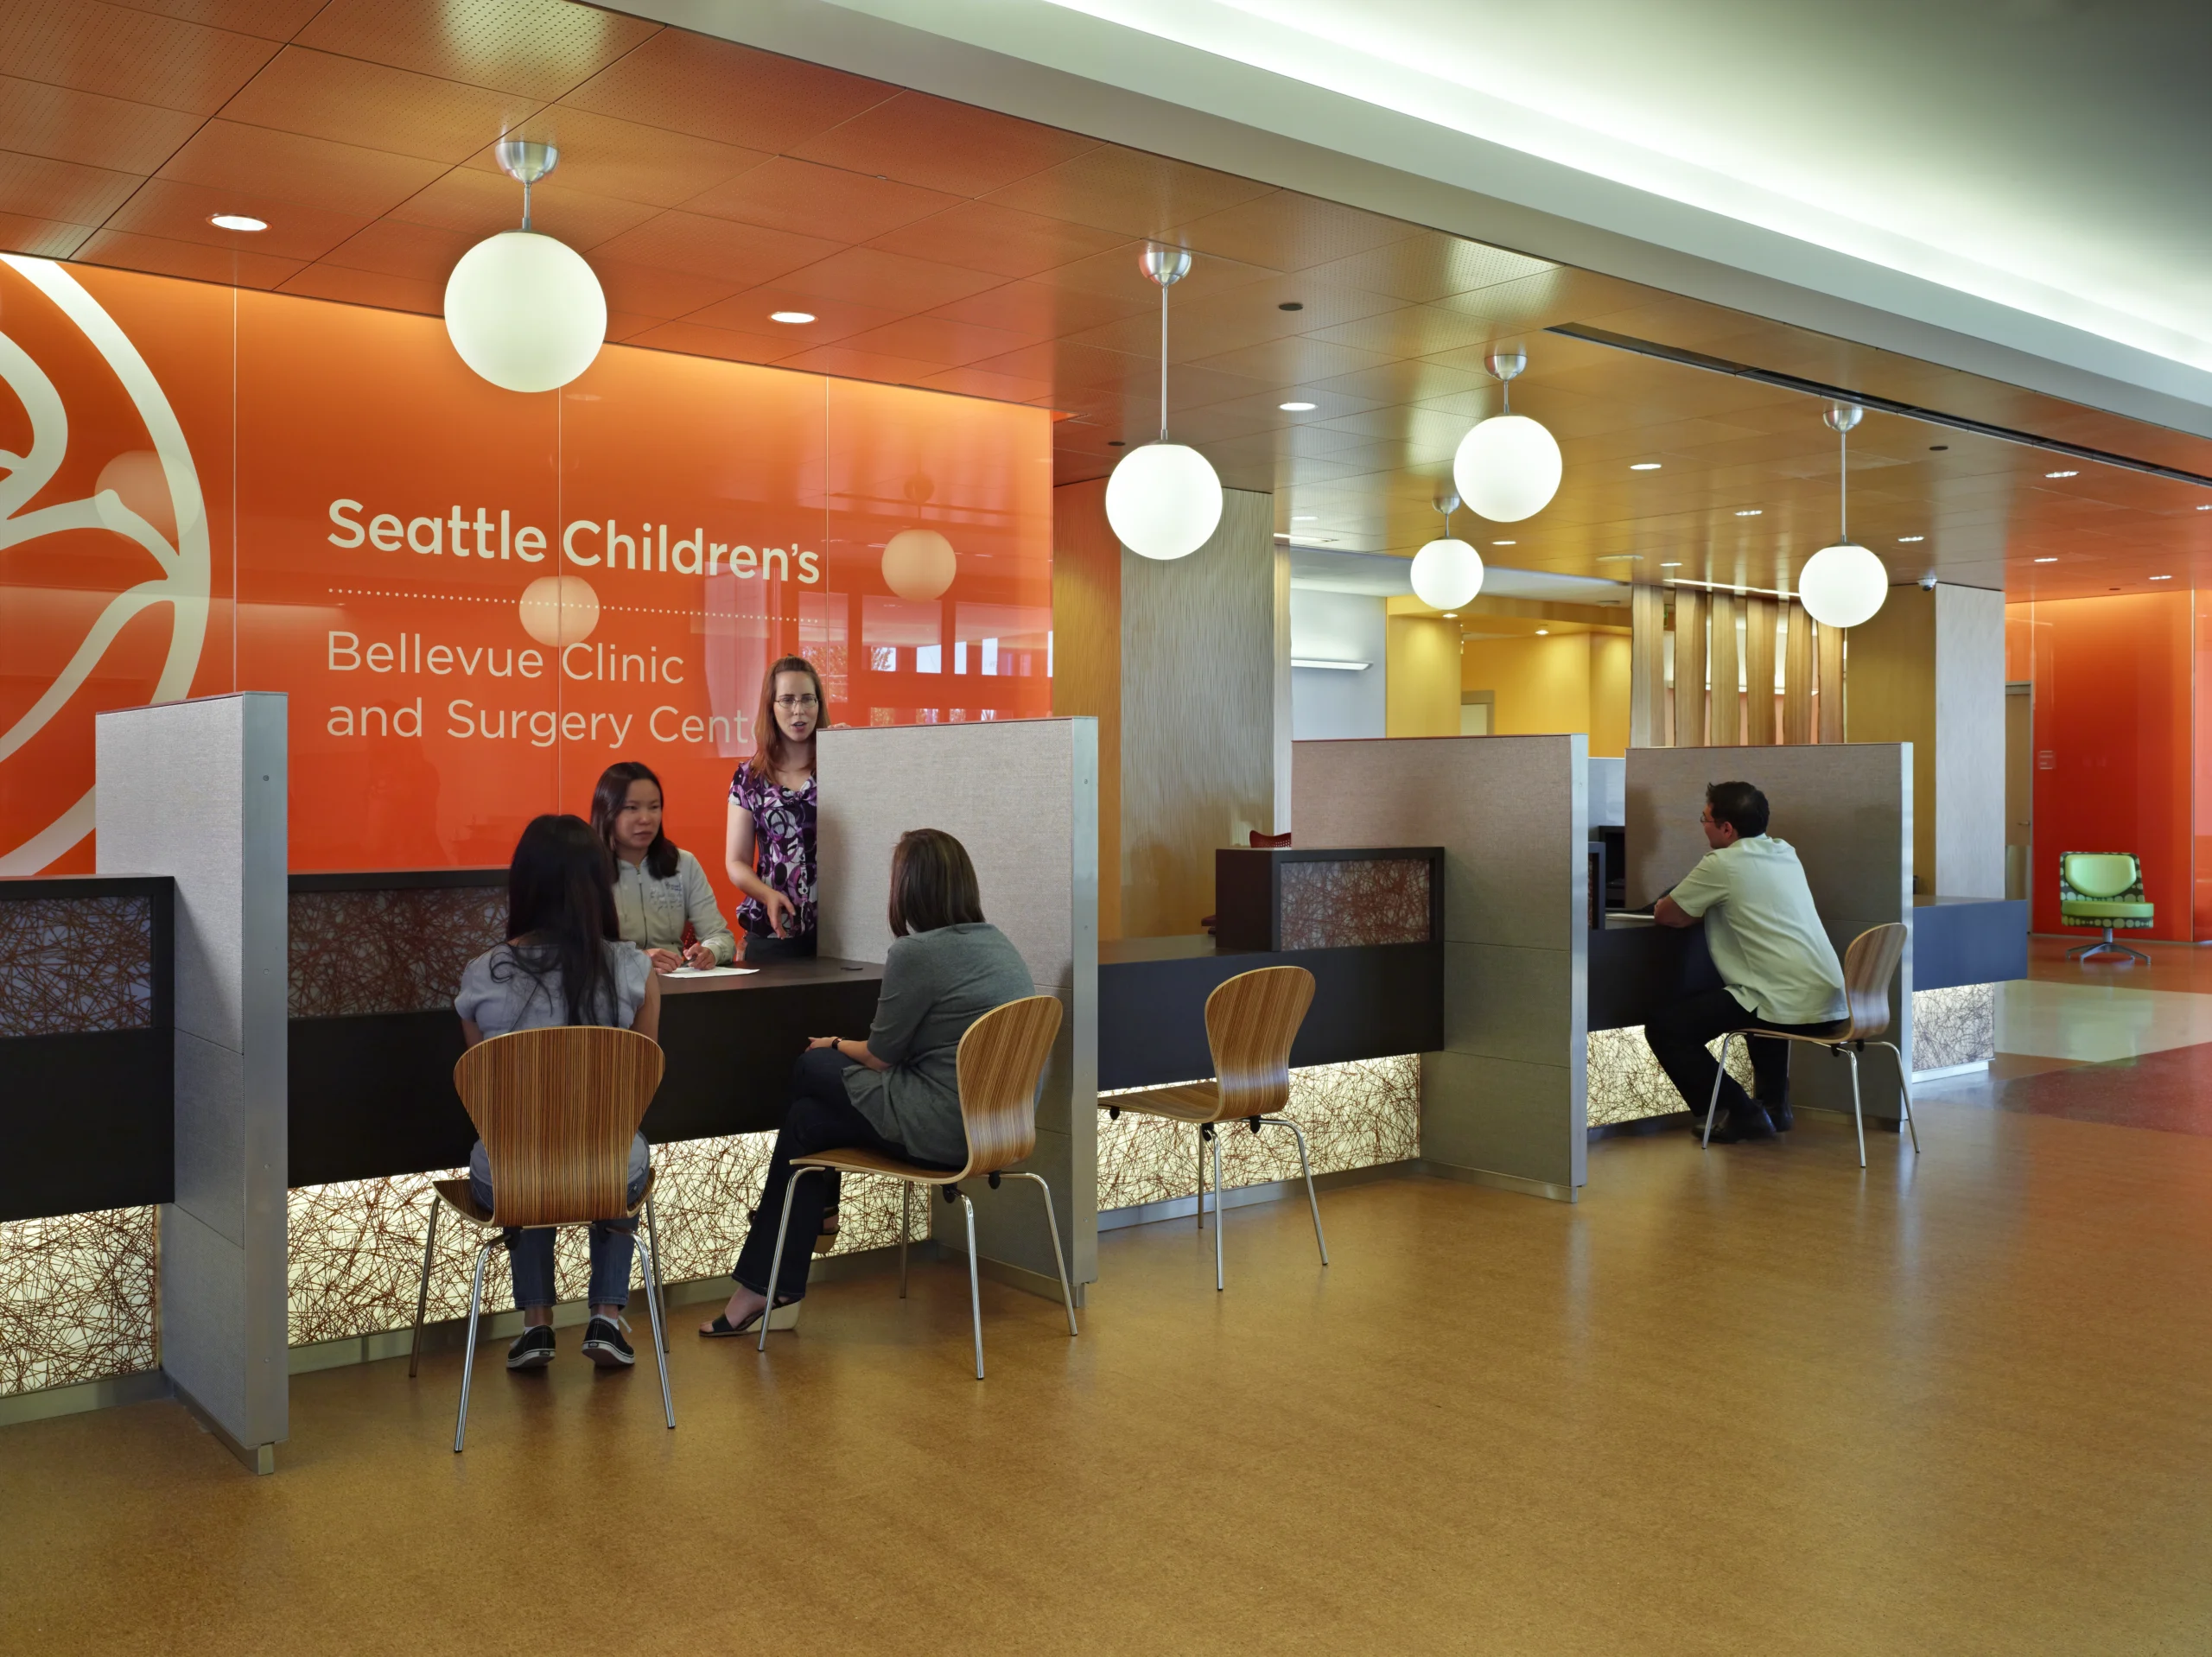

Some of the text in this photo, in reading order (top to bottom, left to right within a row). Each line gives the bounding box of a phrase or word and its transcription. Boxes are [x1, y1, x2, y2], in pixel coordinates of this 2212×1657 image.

[327, 498, 820, 584] Seattle Children’s
[328, 630, 684, 684] Bellevue Clinic
[327, 696, 758, 749] and Surgery Cent
